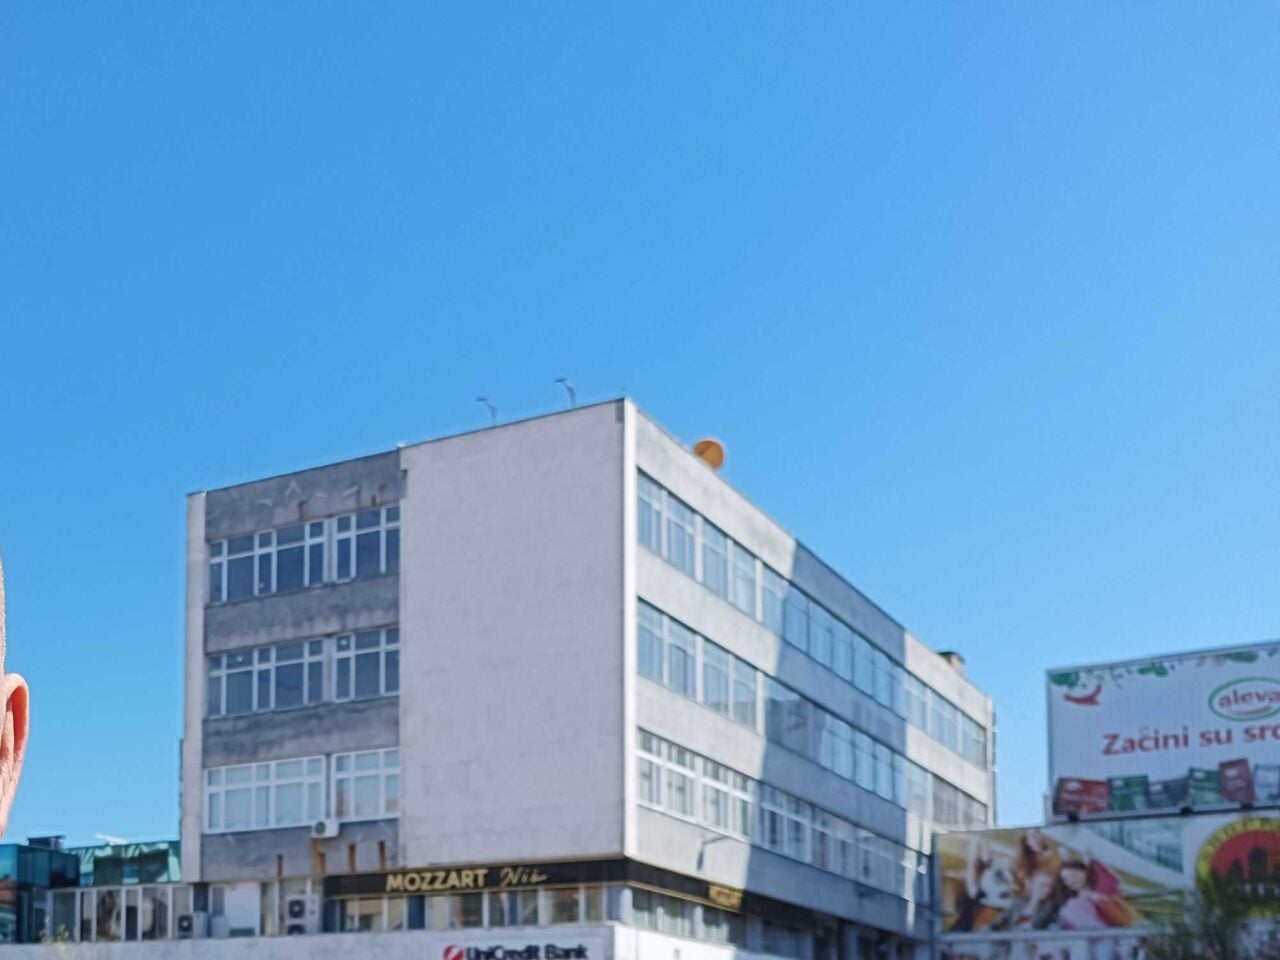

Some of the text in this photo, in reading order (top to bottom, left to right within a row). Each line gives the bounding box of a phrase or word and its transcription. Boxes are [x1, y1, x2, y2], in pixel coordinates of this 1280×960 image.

[1219, 689, 1280, 708] aleva
[1103, 725, 1189, 756] Začini
[1199, 728, 1232, 747] su
[386, 868, 488, 892] MOZZART
[544, 943, 588, 960] Bank
